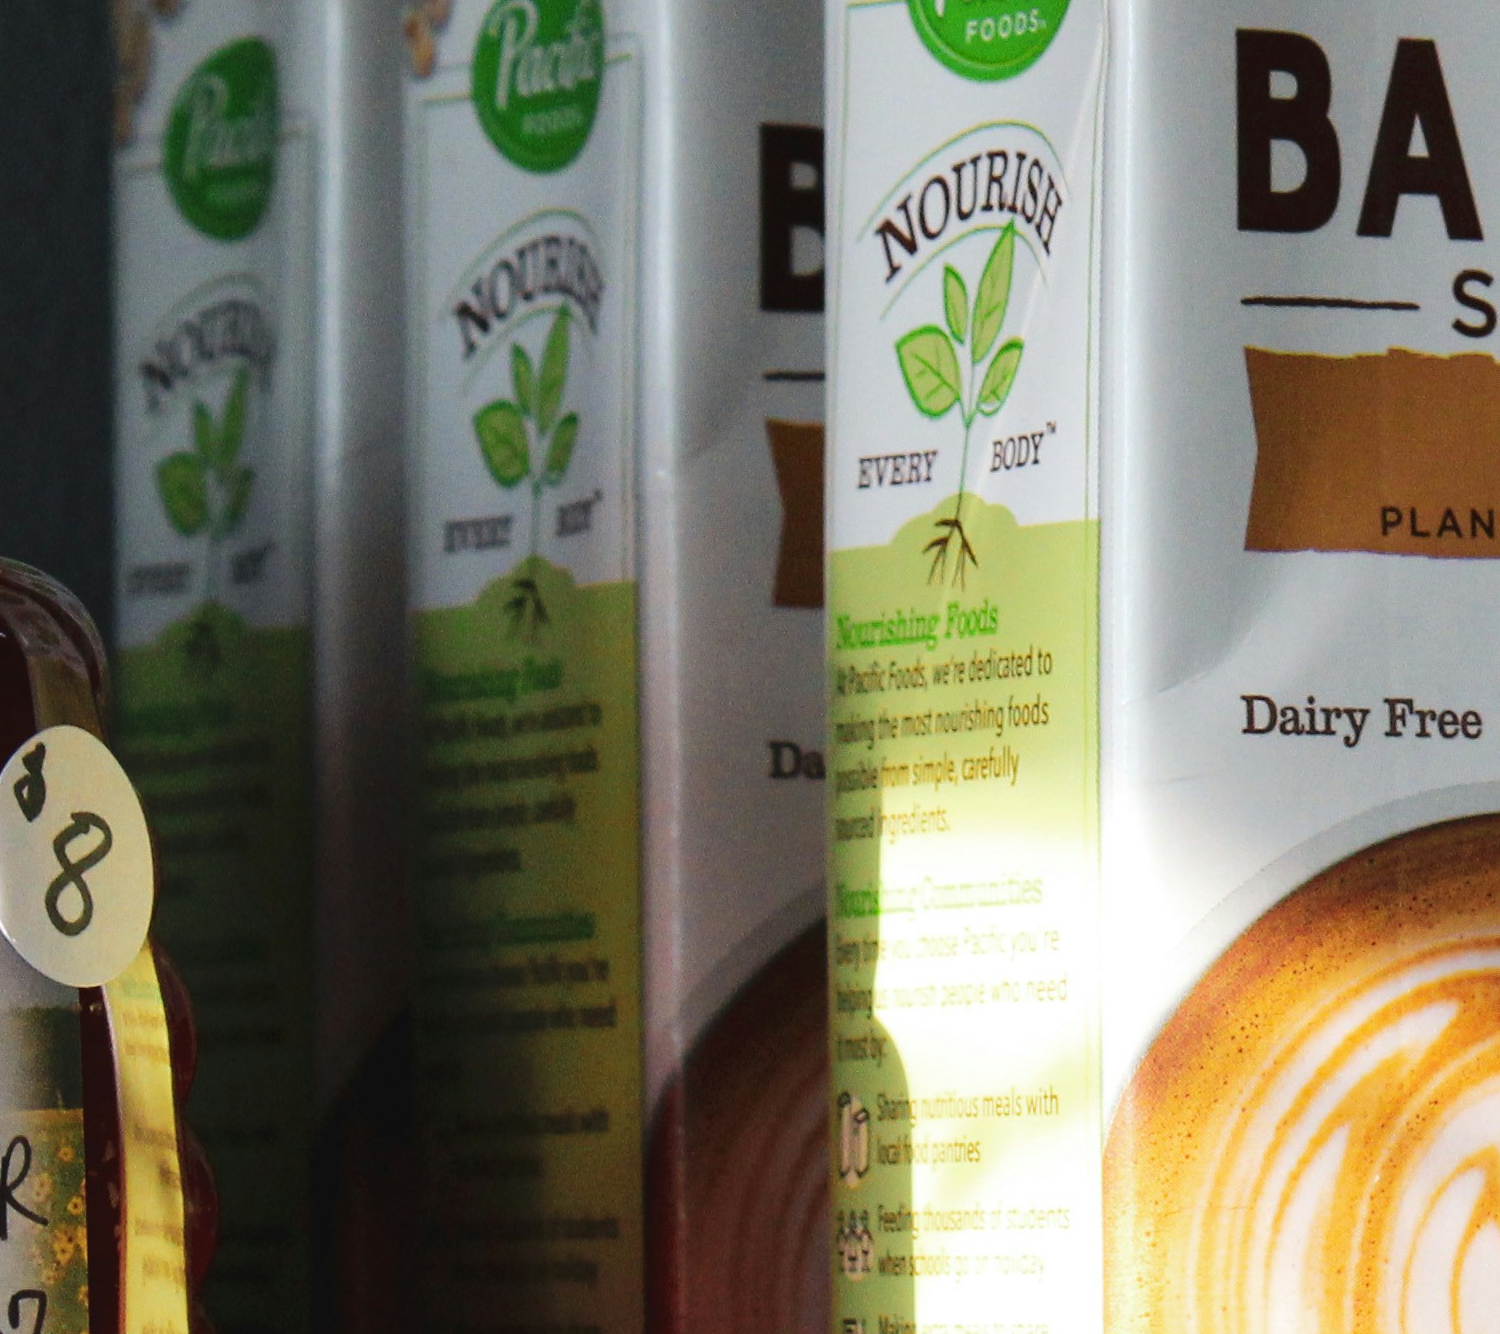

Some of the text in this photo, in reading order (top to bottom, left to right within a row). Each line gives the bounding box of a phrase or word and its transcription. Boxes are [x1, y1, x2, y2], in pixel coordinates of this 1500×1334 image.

[875, 150, 1062, 283] NOURISH
[857, 450, 938, 489] EVERY
[945, 597, 998, 639] Foods
[968, 645, 1033, 682] dedicated
[1038, 647, 1053, 675] to
[935, 698, 1003, 736] nourishing
[1008, 694, 1050, 727] foods
[1239, 695, 1483, 746] Dairy Free
[912, 750, 958, 791] simple,
[961, 745, 1020, 786] carefully
[1026, 971, 1068, 1002] need
[921, 1089, 979, 1118] nutritious
[983, 1087, 1022, 1116] meals
[1026, 1085, 1059, 1115] with
[932, 1132, 981, 1173] pantries
[923, 1203, 985, 1231] thousands
[1005, 1203, 1071, 1231] students
